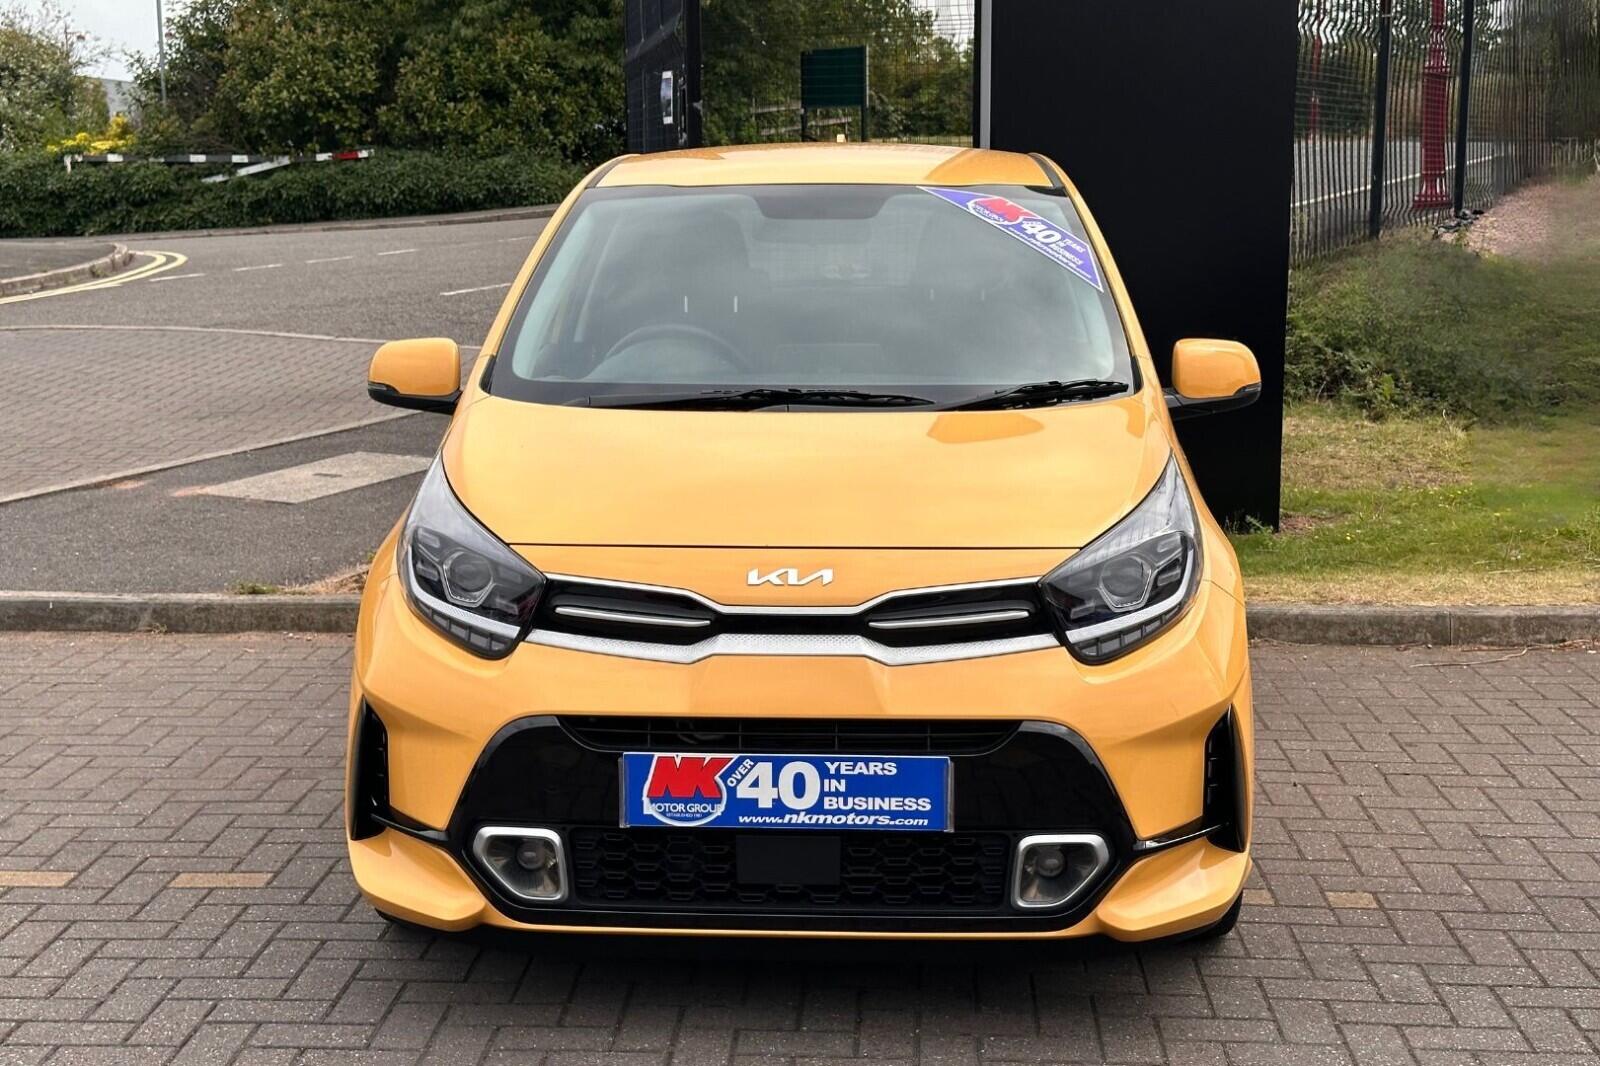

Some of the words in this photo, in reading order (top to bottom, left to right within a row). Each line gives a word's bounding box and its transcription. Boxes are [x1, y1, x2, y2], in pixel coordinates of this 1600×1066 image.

[1021, 222, 1061, 243] 40
[727, 758, 755, 787] OVER
[824, 761, 898, 776] YEARS
[647, 756, 734, 799] NK
[736, 761, 821, 810] 40
[823, 778, 846, 792] IN
[647, 803, 686, 812] MOTOR
[686, 803, 722, 813] GROUP
[823, 796, 932, 811] BUSINESS
[738, 811, 929, 827] www.nkmotors.com
